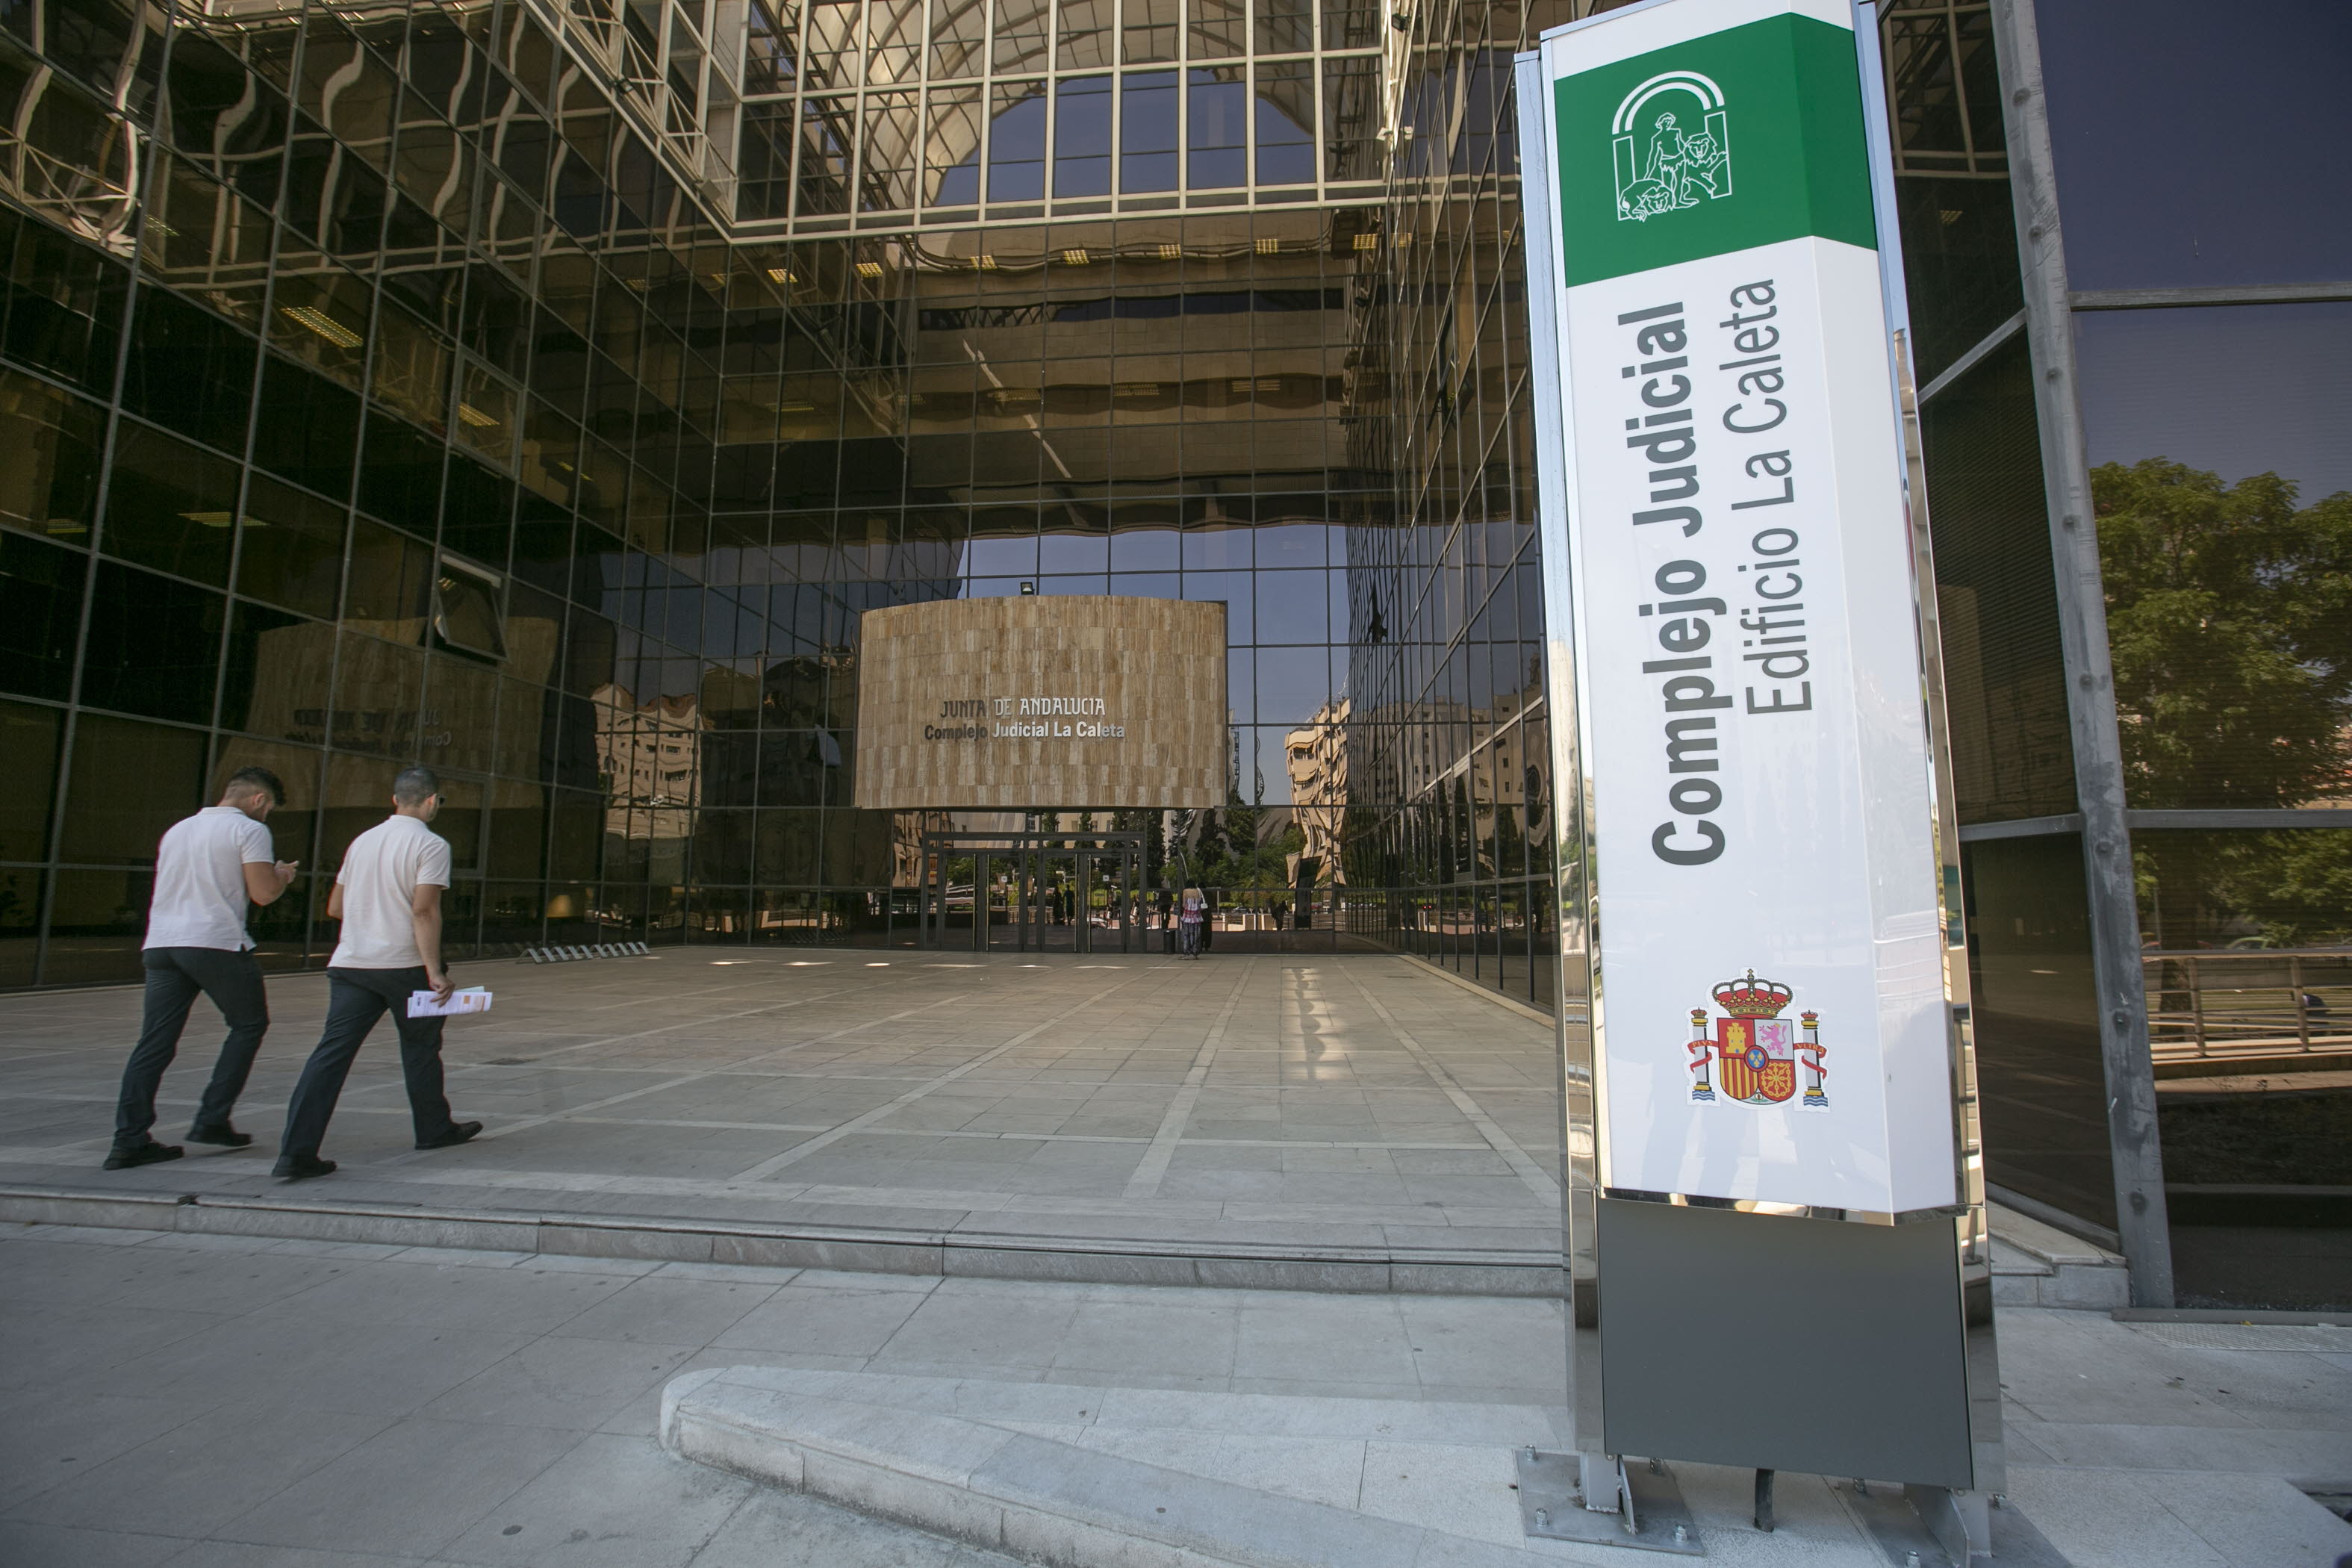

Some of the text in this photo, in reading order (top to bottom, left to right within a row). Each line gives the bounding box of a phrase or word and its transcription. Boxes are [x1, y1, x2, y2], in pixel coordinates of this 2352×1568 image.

[1617, 301, 1734, 866] Complejo Judicial
[1719, 279, 1812, 715] Edificio La Caleta
[924, 721, 1125, 742] Complejo Judicial La Caleta
[940, 697, 1106, 718] JUNTA DE ANDALUCIA
